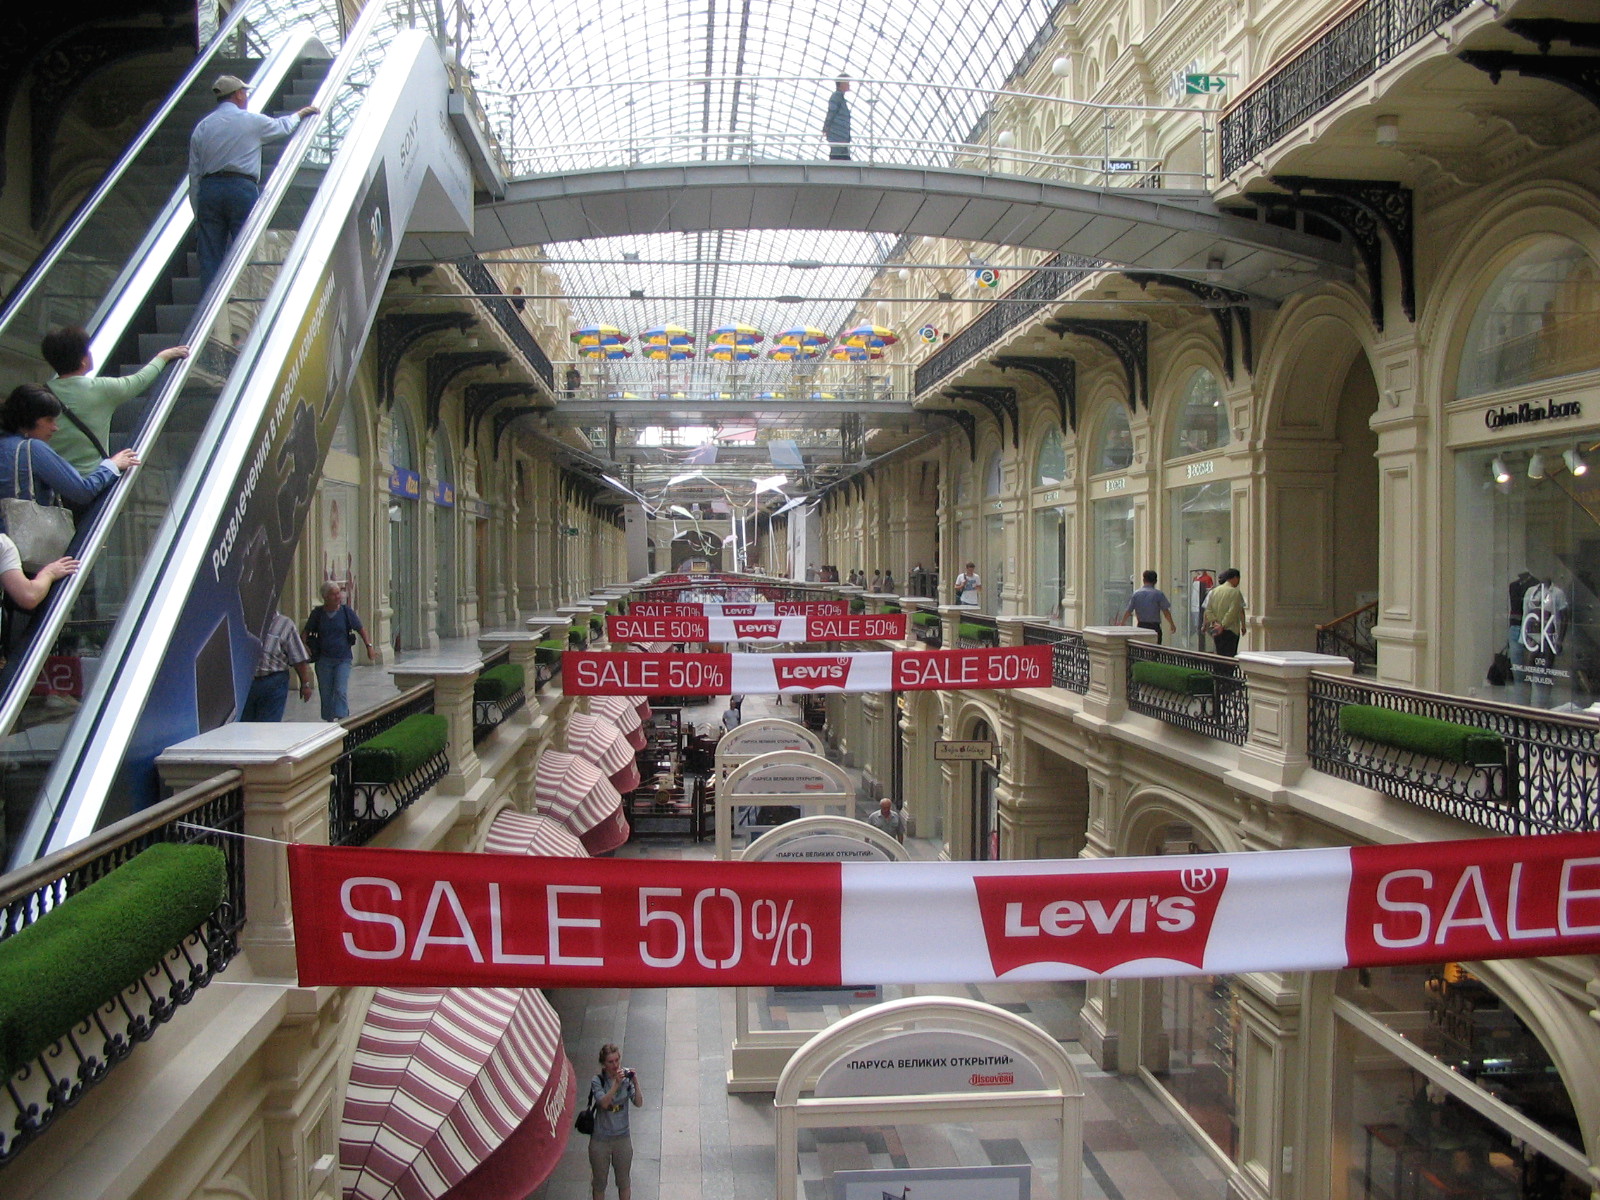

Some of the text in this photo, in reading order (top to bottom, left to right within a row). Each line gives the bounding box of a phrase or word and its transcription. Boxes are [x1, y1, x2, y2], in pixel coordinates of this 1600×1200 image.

[401, 109, 418, 168] SONY
[1485, 399, 1580, 428] Calvin Klein Jeans
[635, 604, 673, 617] SALE
[675, 605, 701, 616] 50%
[777, 605, 814, 617] SALE
[817, 604, 841, 616] 50%
[616, 621, 665, 638] SALE
[671, 621, 704, 638] 50%
[811, 620, 860, 638] SALE
[865, 619, 898, 636] 50%
[577, 660, 660, 688] SALE
[669, 661, 723, 689] 50%
[900, 656, 979, 686] SALE
[987, 655, 1040, 682] 50%
[340, 875, 604, 967] SALE
[638, 886, 812, 970] 50%
[1372, 857, 1600, 949] SALE
[846, 1055, 1014, 1070] «ПАРУСА ВЕЛИКИХ ОТКРЫТИЙ»
